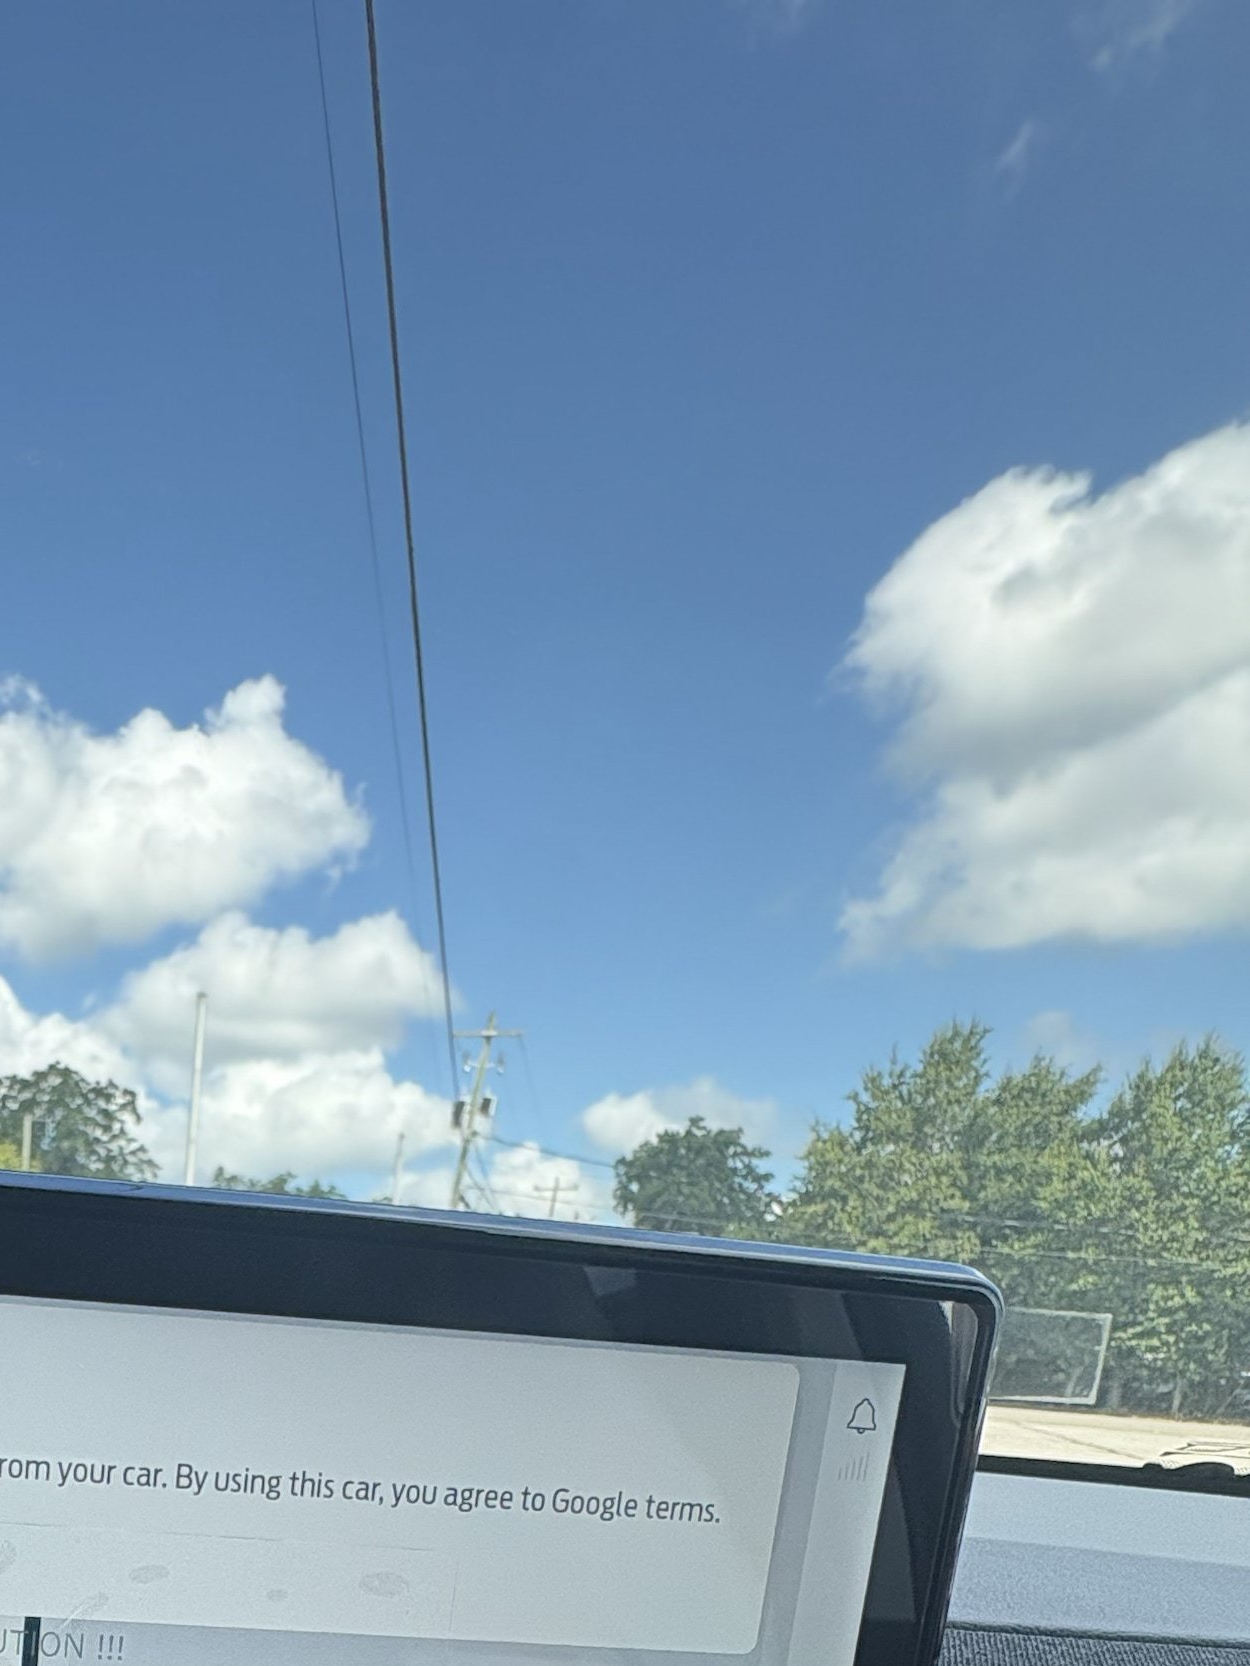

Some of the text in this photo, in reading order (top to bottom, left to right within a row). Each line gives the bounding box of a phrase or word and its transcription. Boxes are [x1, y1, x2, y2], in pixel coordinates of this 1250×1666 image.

[57, 1461, 117, 1488] your
[122, 1466, 168, 1489] car.
[175, 1462, 209, 1496] By
[214, 1467, 282, 1501] using
[289, 1470, 335, 1499] this
[341, 1480, 384, 1506] car,
[391, 1483, 440, 1510] you
[443, 1486, 514, 1513] agree
[521, 1486, 546, 1512] to
[551, 1487, 638, 1522] Google
[645, 1494, 720, 1524] terms.
[97, 1634, 124, 1661] !!!
